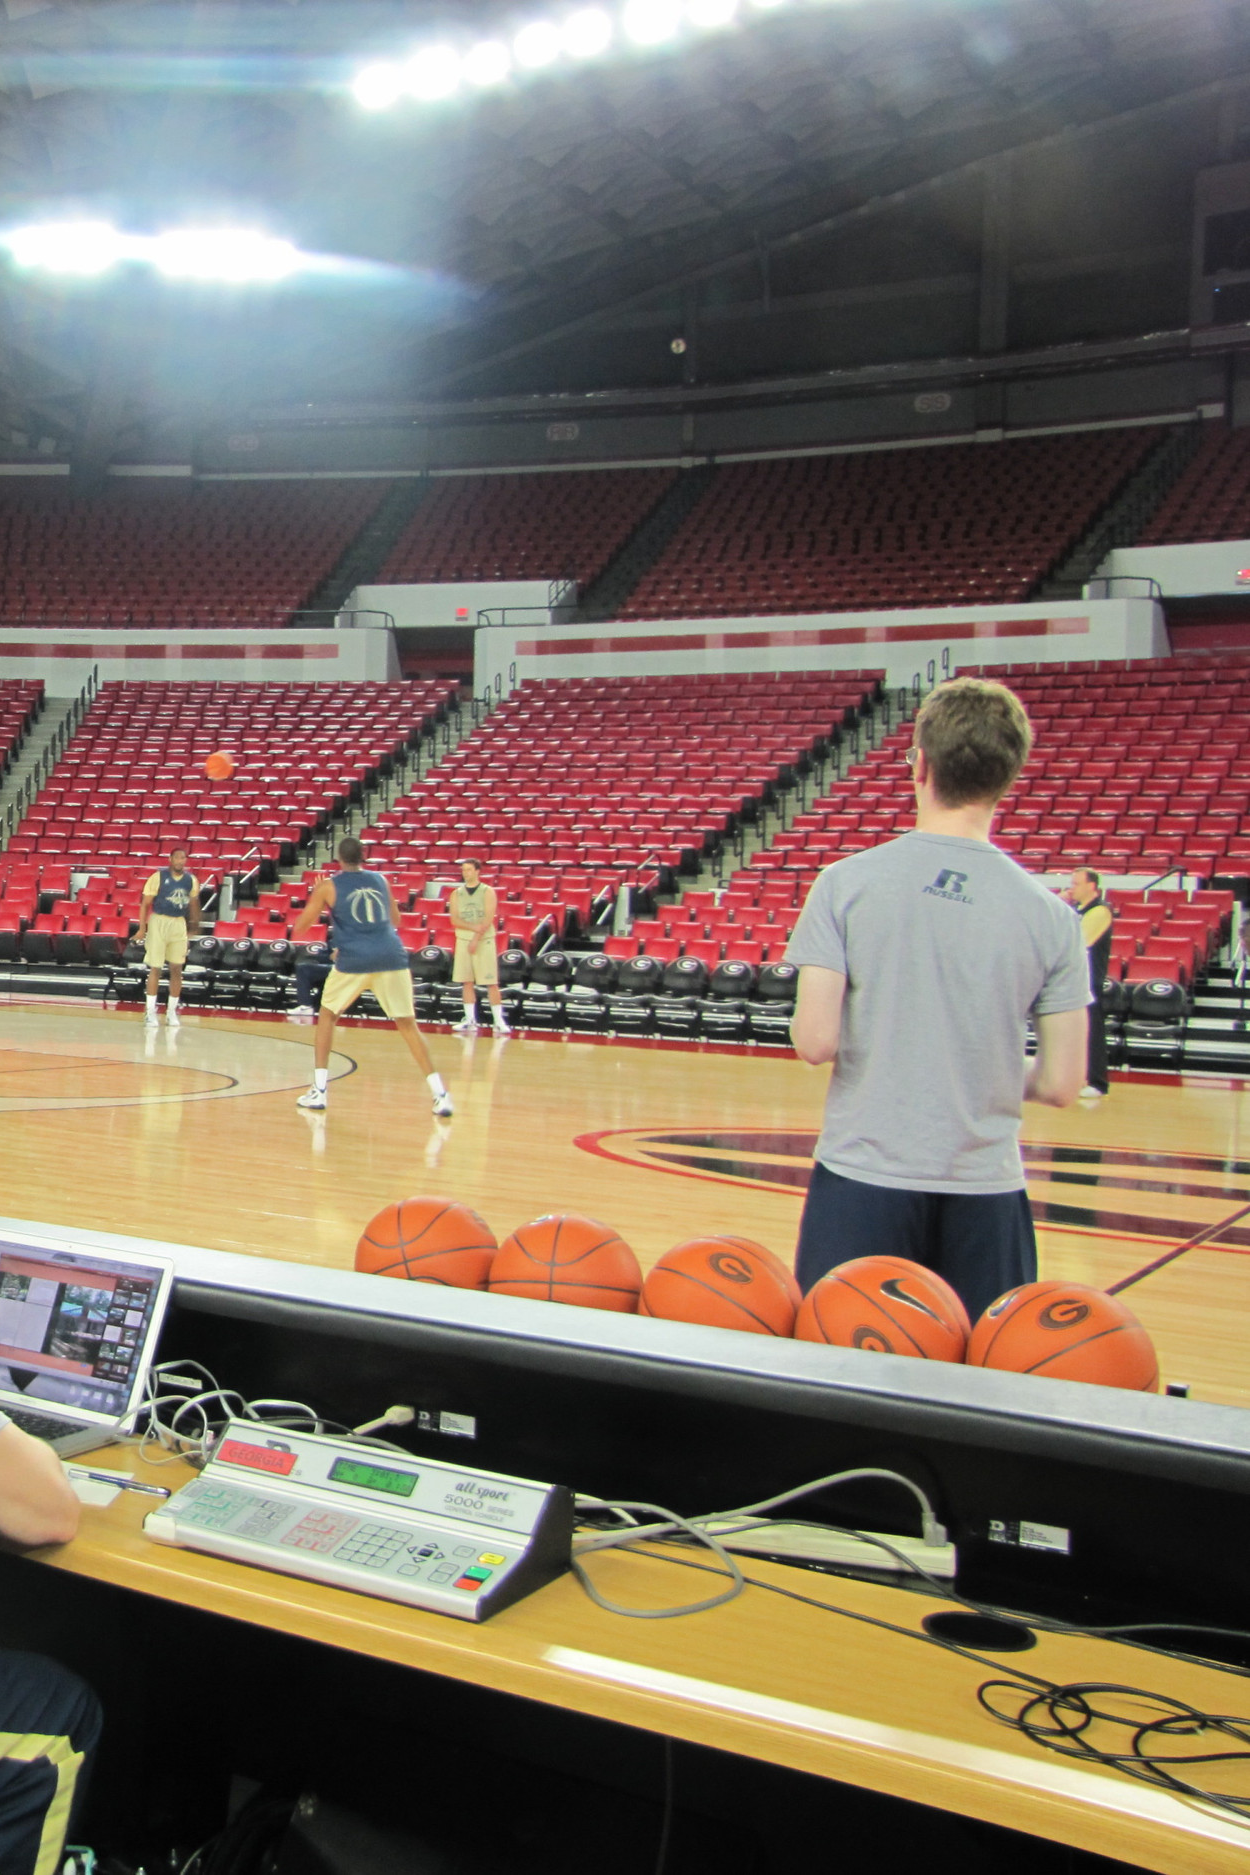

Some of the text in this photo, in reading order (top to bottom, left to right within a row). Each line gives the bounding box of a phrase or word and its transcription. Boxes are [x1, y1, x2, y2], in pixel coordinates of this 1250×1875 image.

[709, 1251, 753, 1284] G
[1039, 1299, 1090, 1331] G
[227, 1446, 285, 1470] GEORGIA
[444, 1493, 484, 1510] 5000
[455, 1481, 510, 1501] all sport
